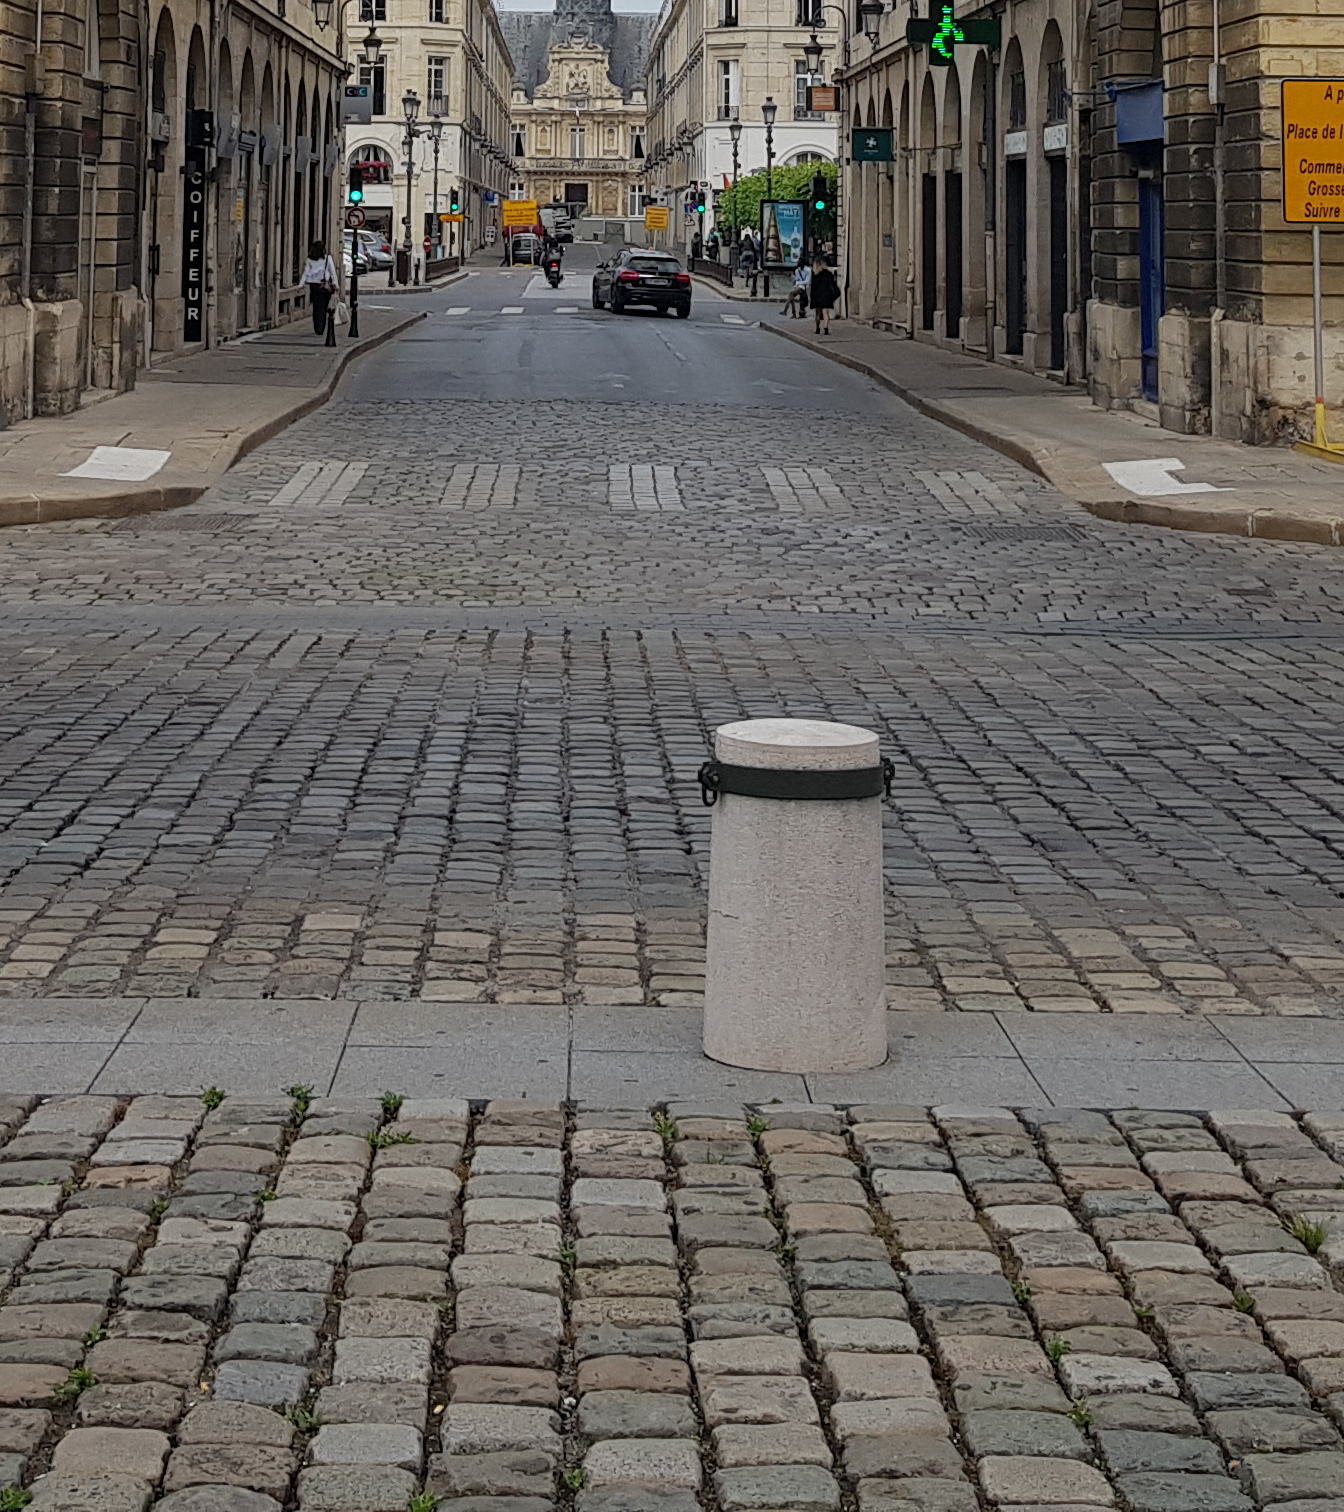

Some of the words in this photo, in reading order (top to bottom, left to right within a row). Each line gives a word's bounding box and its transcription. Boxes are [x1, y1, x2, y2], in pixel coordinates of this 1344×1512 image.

[1324, 85, 1333, 101] A
[1286, 123, 1318, 140] Place
[1322, 124, 1336, 139] de
[1304, 202, 1341, 218] Suivre
[187, 172, 203, 321] COIFFEUR
